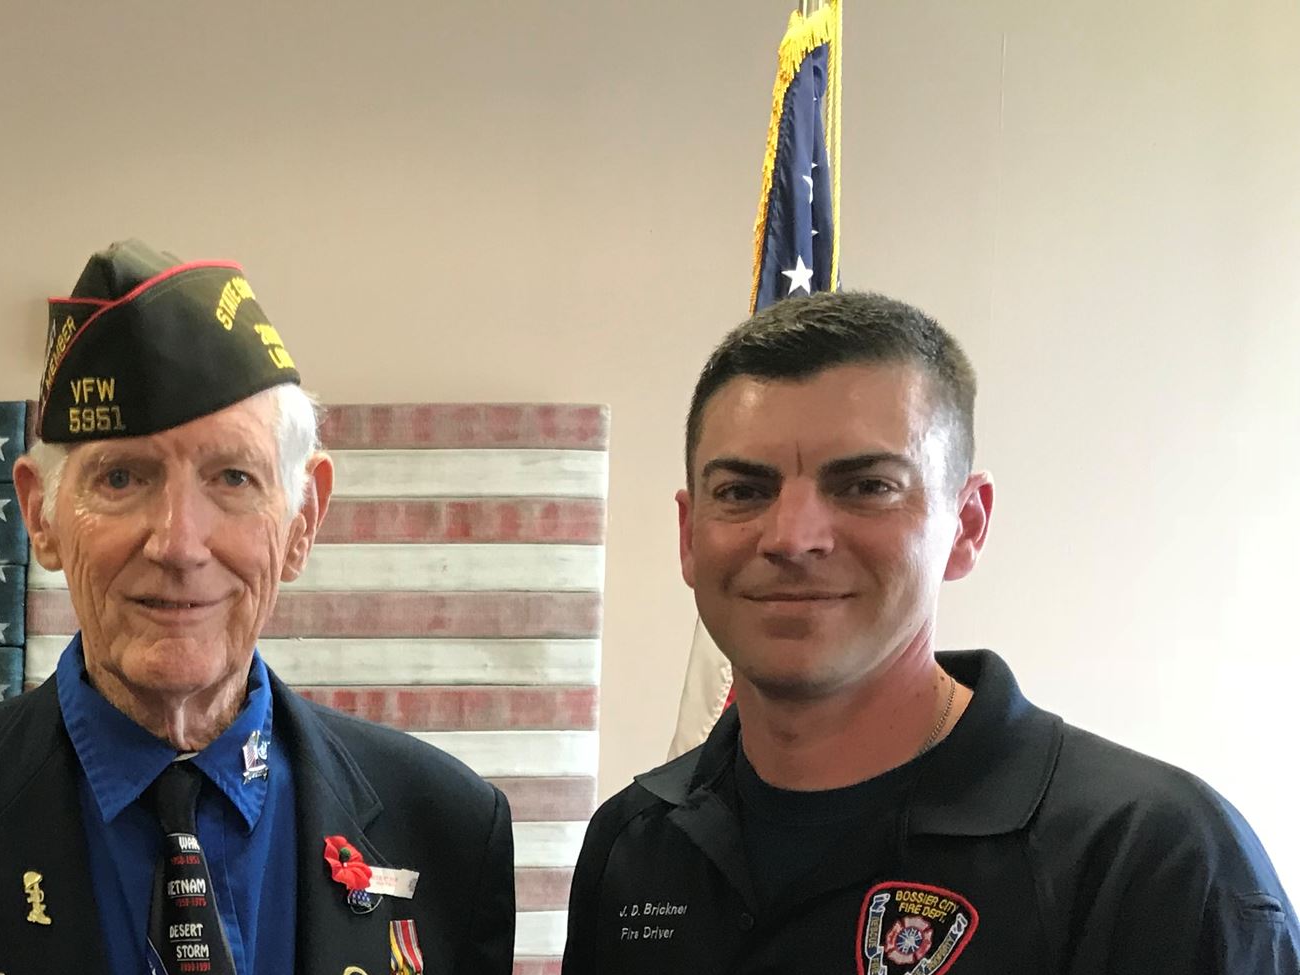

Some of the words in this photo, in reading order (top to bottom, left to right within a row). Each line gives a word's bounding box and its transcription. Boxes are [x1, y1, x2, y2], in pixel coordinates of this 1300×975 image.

[70, 377, 115, 404] VFW
[178, 836, 200, 850] WAR
[895, 890, 939, 907] BOSSIER
[939, 899, 960, 914] CITY
[898, 902, 922, 915] FIRE
[620, 905, 628, 917] J.
[631, 904, 641, 916] D.
[170, 923, 203, 938] DESERT
[621, 927, 639, 940] Fire
[643, 926, 675, 939] Driver
[176, 944, 209, 958] STORM
